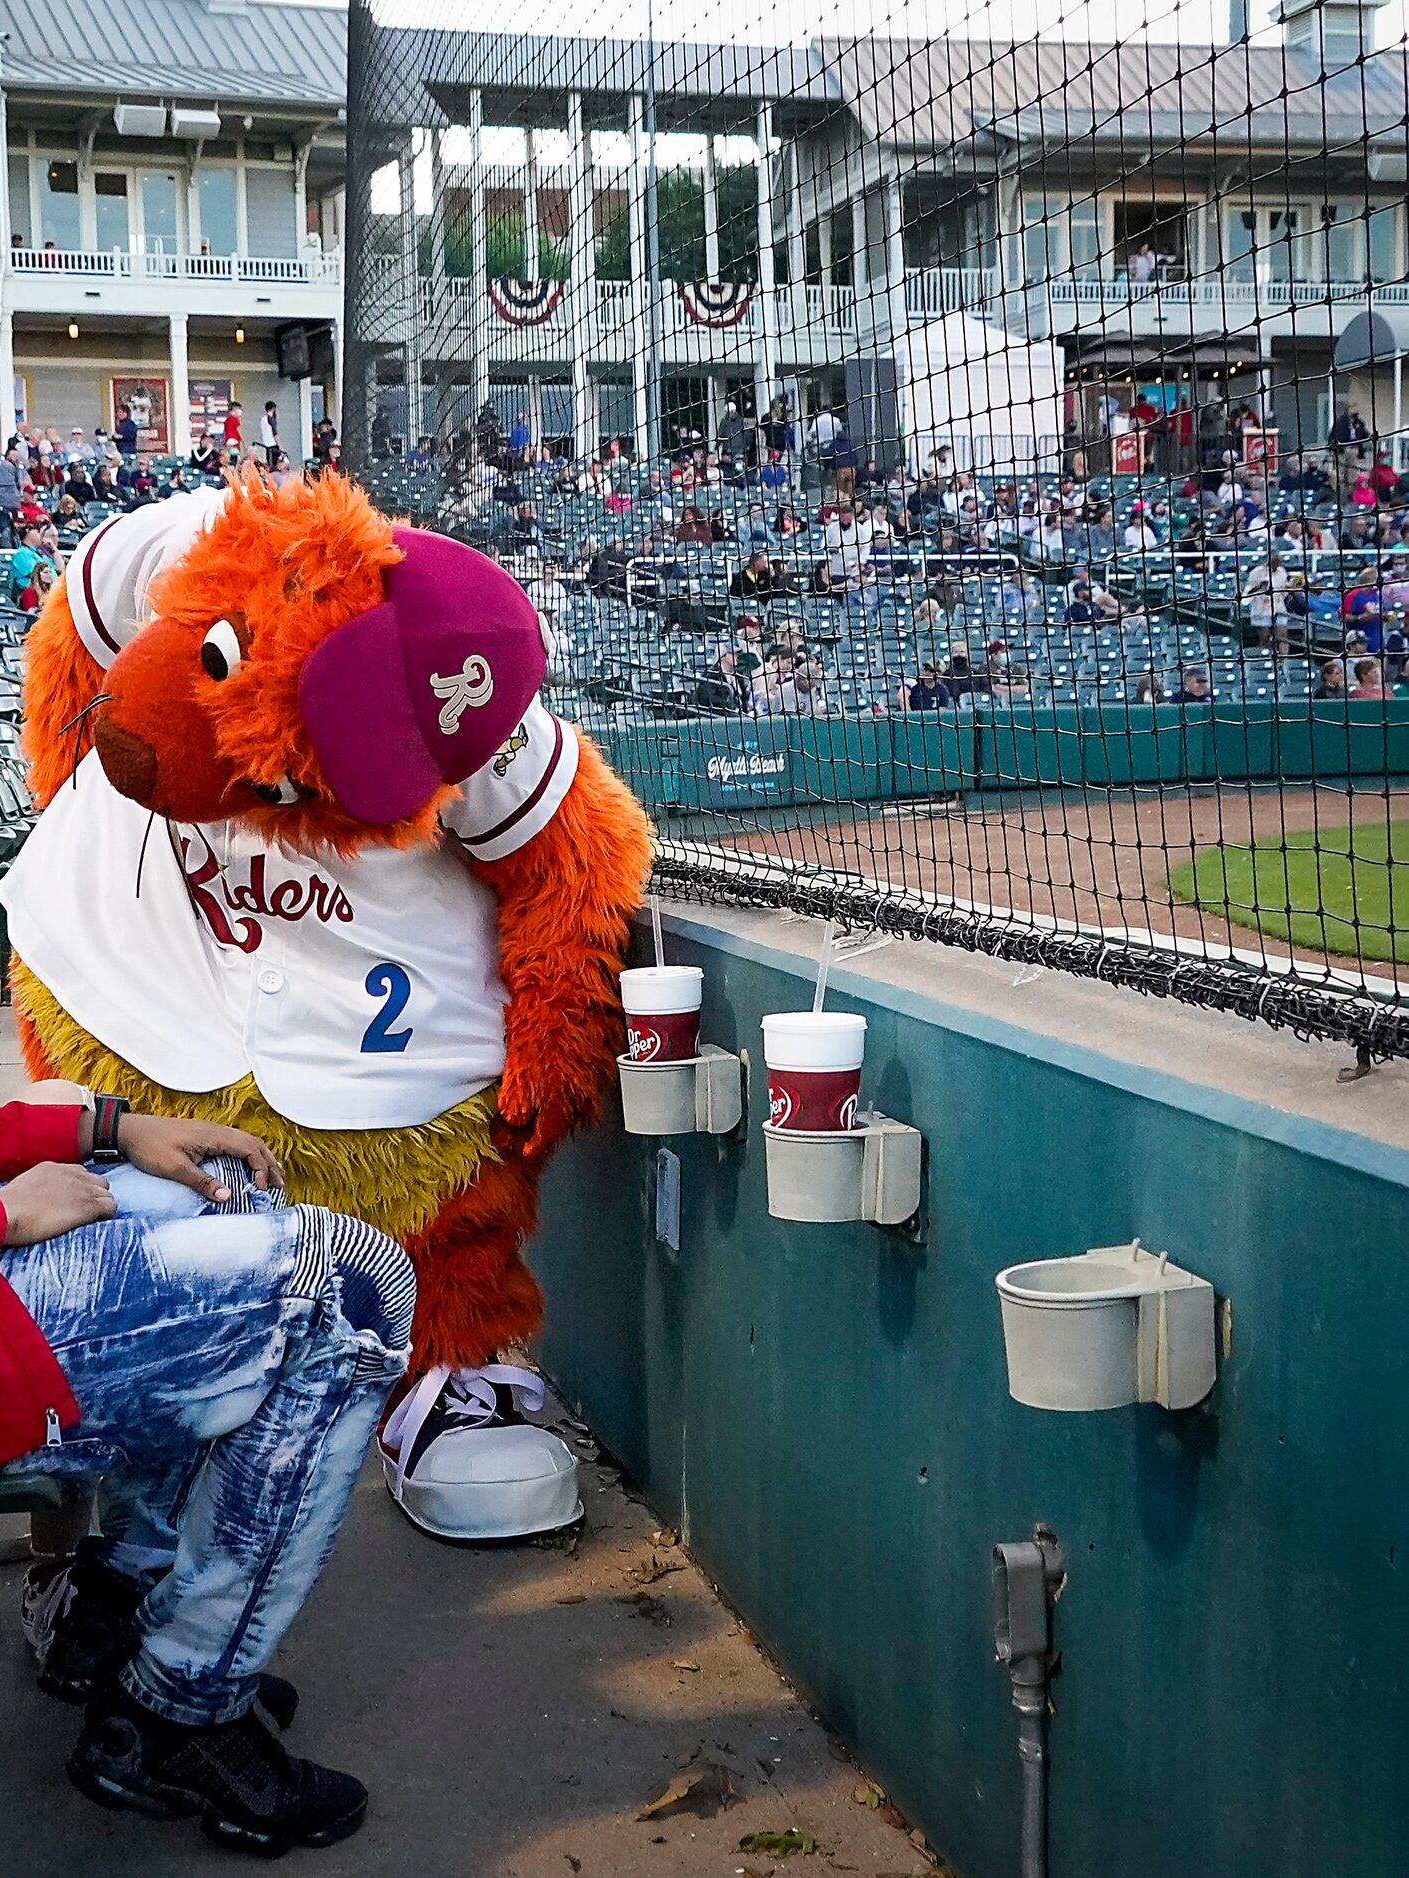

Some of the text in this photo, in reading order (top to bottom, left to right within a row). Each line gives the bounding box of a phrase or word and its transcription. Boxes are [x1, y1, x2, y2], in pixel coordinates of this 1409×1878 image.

[429, 654, 494, 735] R
[180, 823, 354, 954] Riders
[360, 962, 413, 1053] 2
[627, 1028, 641, 1046] Dr
[629, 1036, 656, 1061] pper
